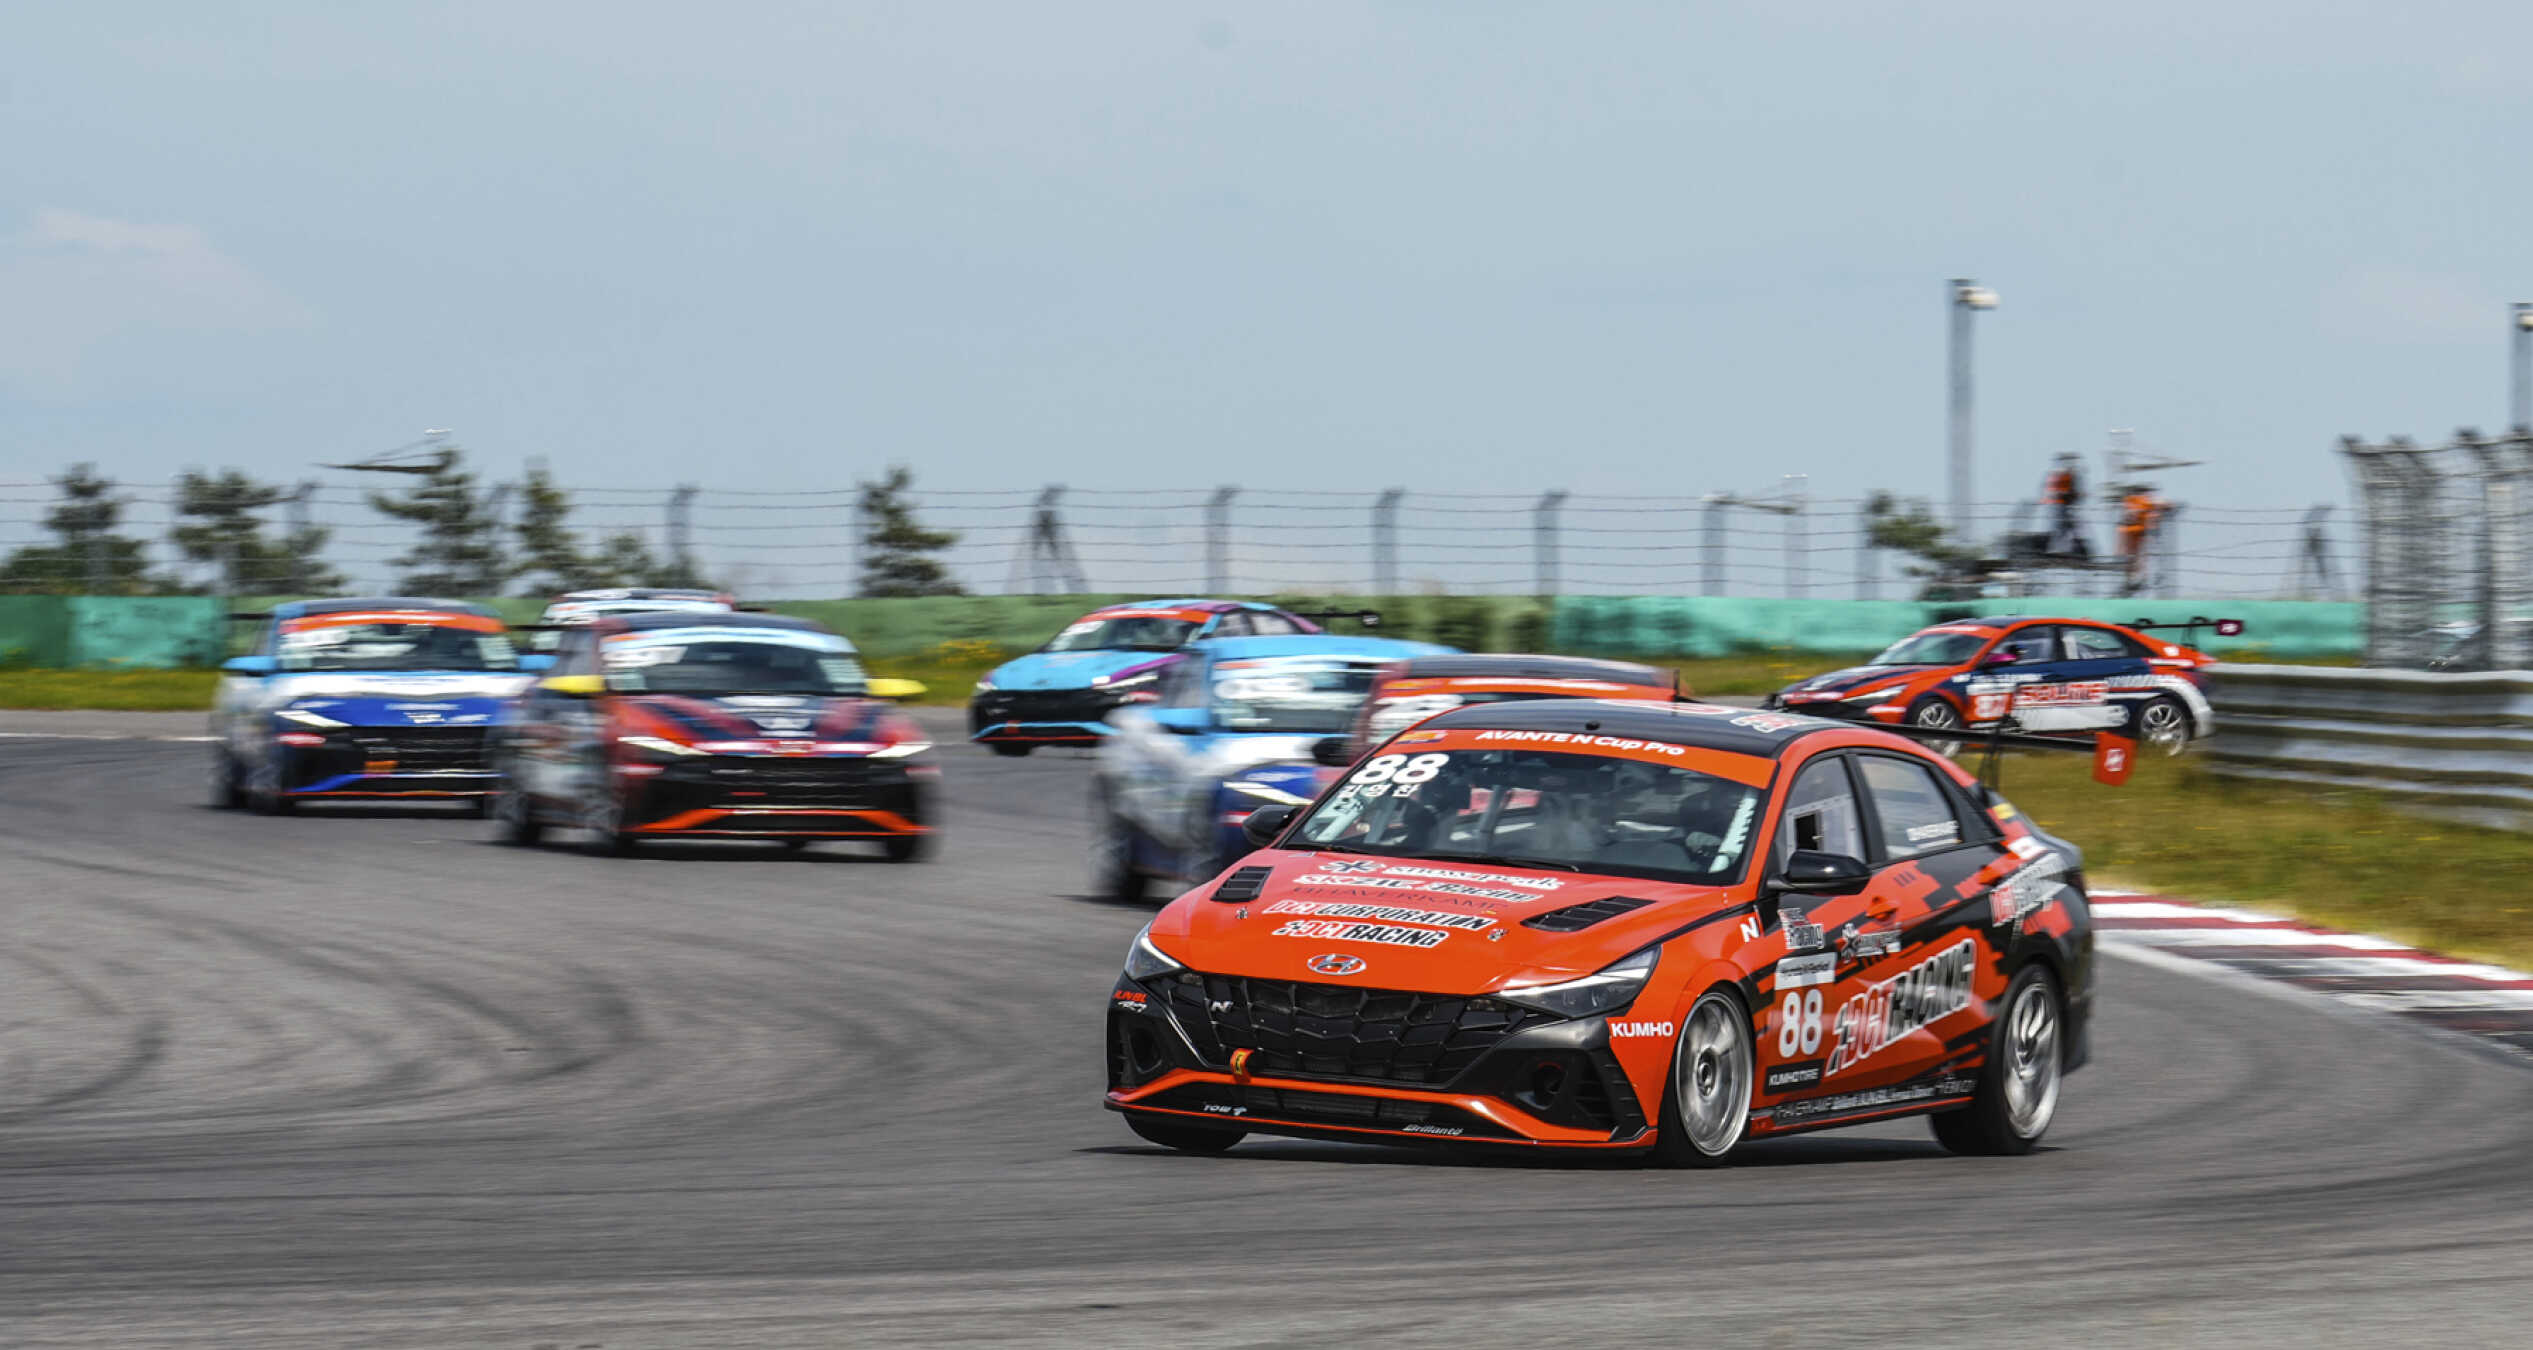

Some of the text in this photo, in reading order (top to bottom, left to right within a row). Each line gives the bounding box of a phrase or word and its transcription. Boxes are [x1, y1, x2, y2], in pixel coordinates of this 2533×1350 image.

[1475, 730, 1686, 756] AVANTE N Cup Pro
[1350, 753, 1450, 784] 88
[1739, 917, 1760, 943] N
[1611, 1021, 1674, 1037] KUMHO
[1778, 988, 1824, 1059] 88
